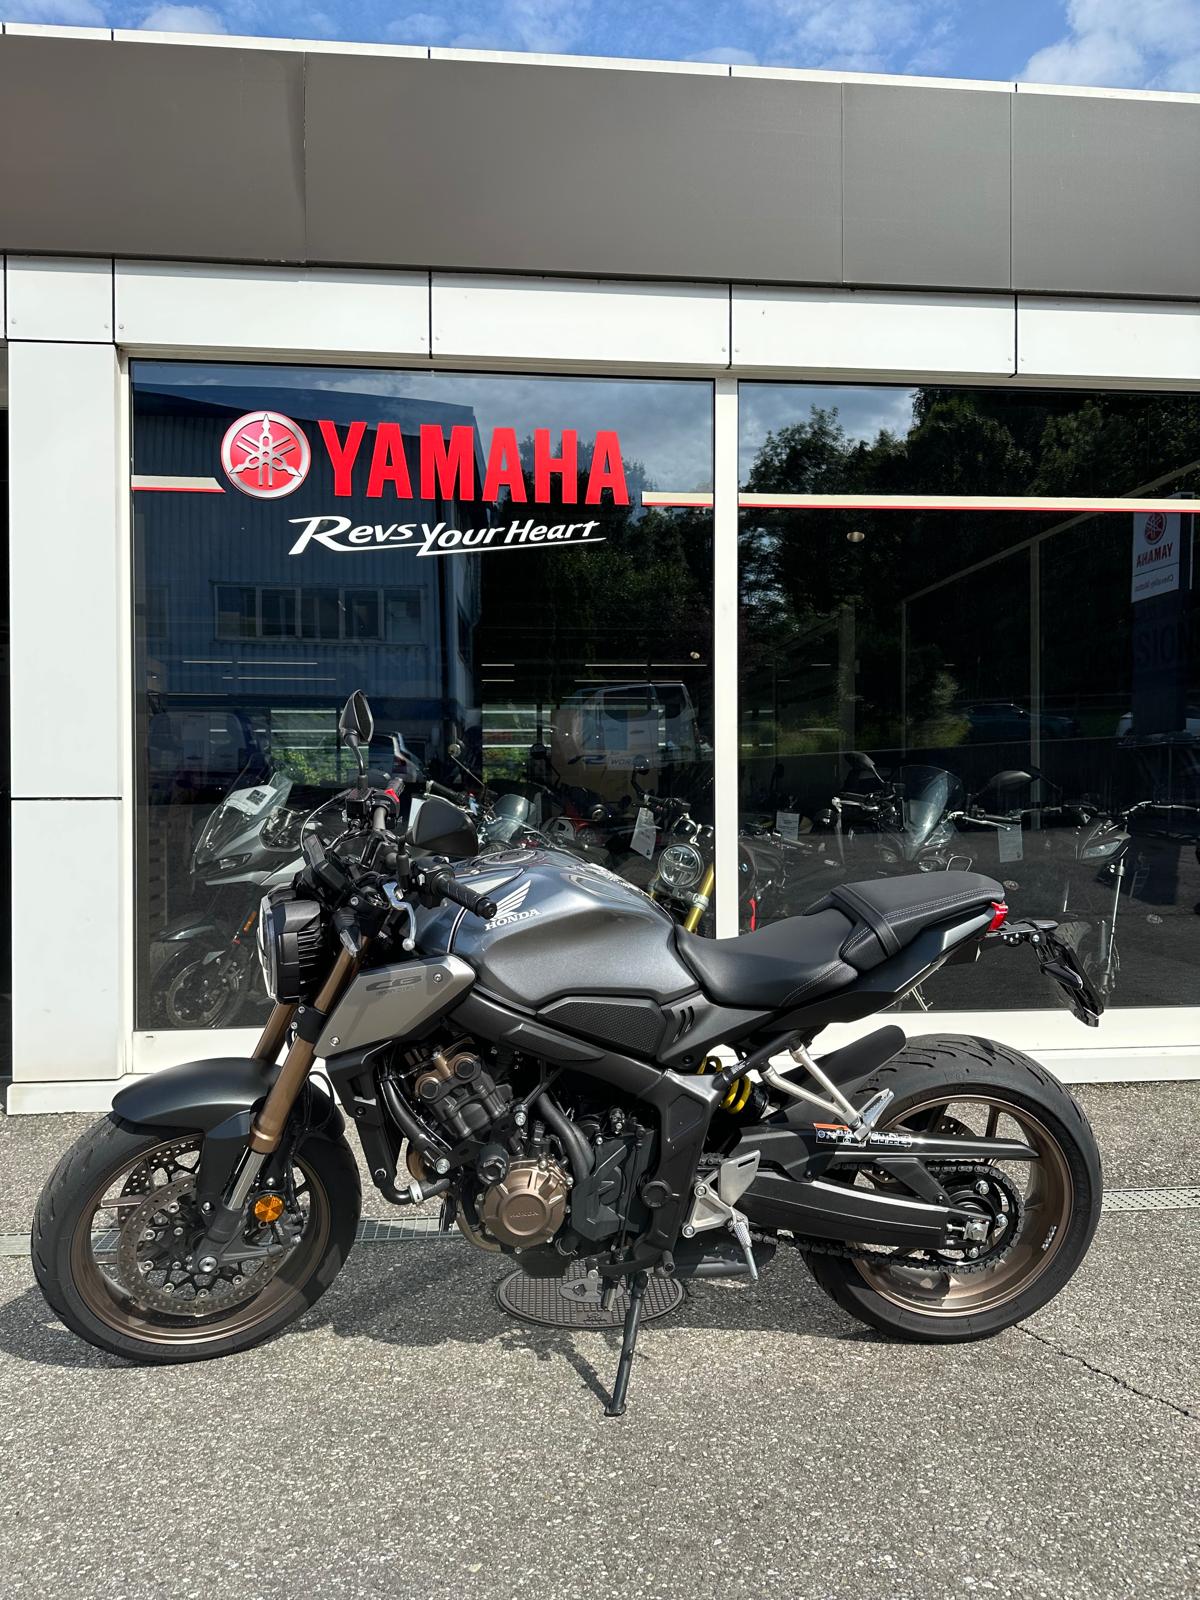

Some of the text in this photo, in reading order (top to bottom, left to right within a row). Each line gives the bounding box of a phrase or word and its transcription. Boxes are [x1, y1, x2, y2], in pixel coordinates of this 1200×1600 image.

[318, 420, 629, 506] YAMAHA
[288, 515, 602, 557] Revs Your Heart
[484, 908, 541, 931] HONDA
